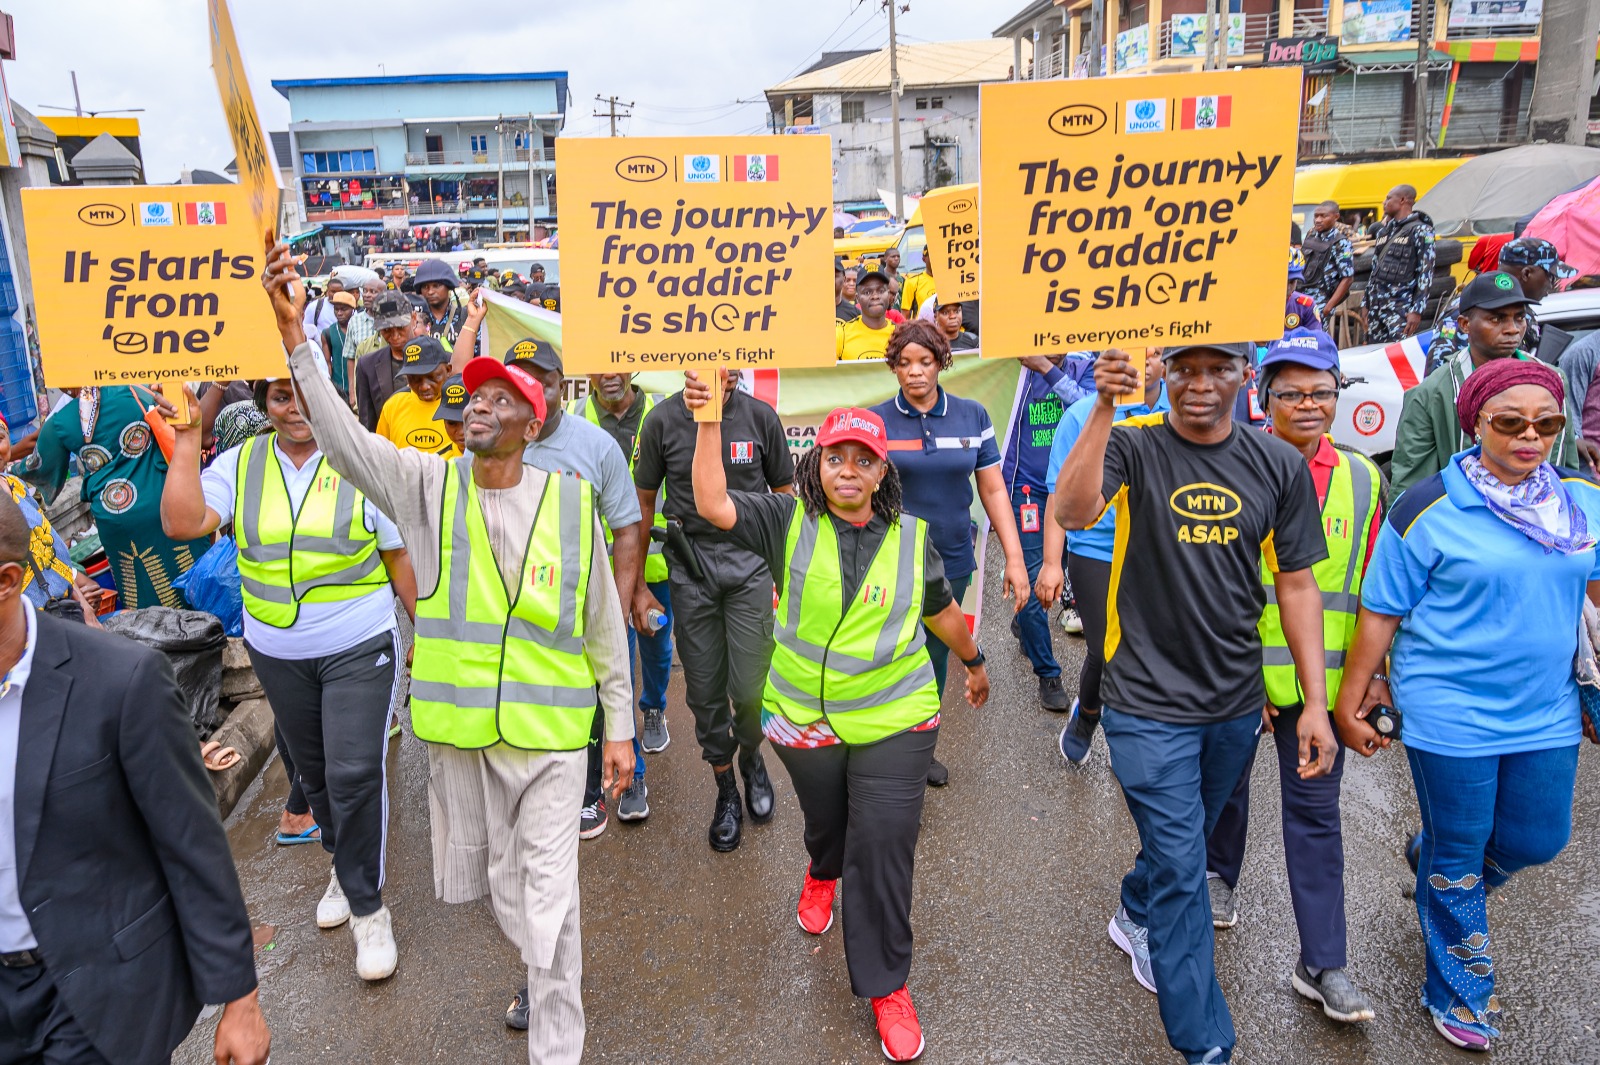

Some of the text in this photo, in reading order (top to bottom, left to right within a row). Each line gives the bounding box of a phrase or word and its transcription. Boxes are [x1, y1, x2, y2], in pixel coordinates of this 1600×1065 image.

[1063, 114, 1093, 126] MTN
[1128, 121, 1161, 130] UNODC
[628, 165, 655, 173] MTN
[688, 172, 716, 180] UNODC
[1019, 158, 1098, 195] The
[90, 211, 114, 219] MTN
[591, 200, 662, 229] The
[1029, 190, 1249, 236] from 'one'
[939, 223, 972, 238] The
[602, 234, 799, 264] from 'one'
[1022, 228, 1238, 274] to 'addict'
[64, 249, 254, 283] It starts
[948, 257, 965, 269] to
[598, 266, 792, 298] to 'addict'
[961, 270, 975, 284] is
[105, 285, 218, 318] from
[1045, 280, 1080, 313] is
[620, 305, 651, 334] is
[1035, 320, 1212, 346] It's everyone's fight
[611, 348, 775, 364] It's everyone's fight
[95, 365, 239, 380] It's everyone's fight
[561, 379, 592, 403] TE
[1029, 400, 1063, 413] MEDIC
[786, 426, 822, 437] GA
[1186, 495, 1224, 512] MTN
[1178, 525, 1238, 544] ASAP
